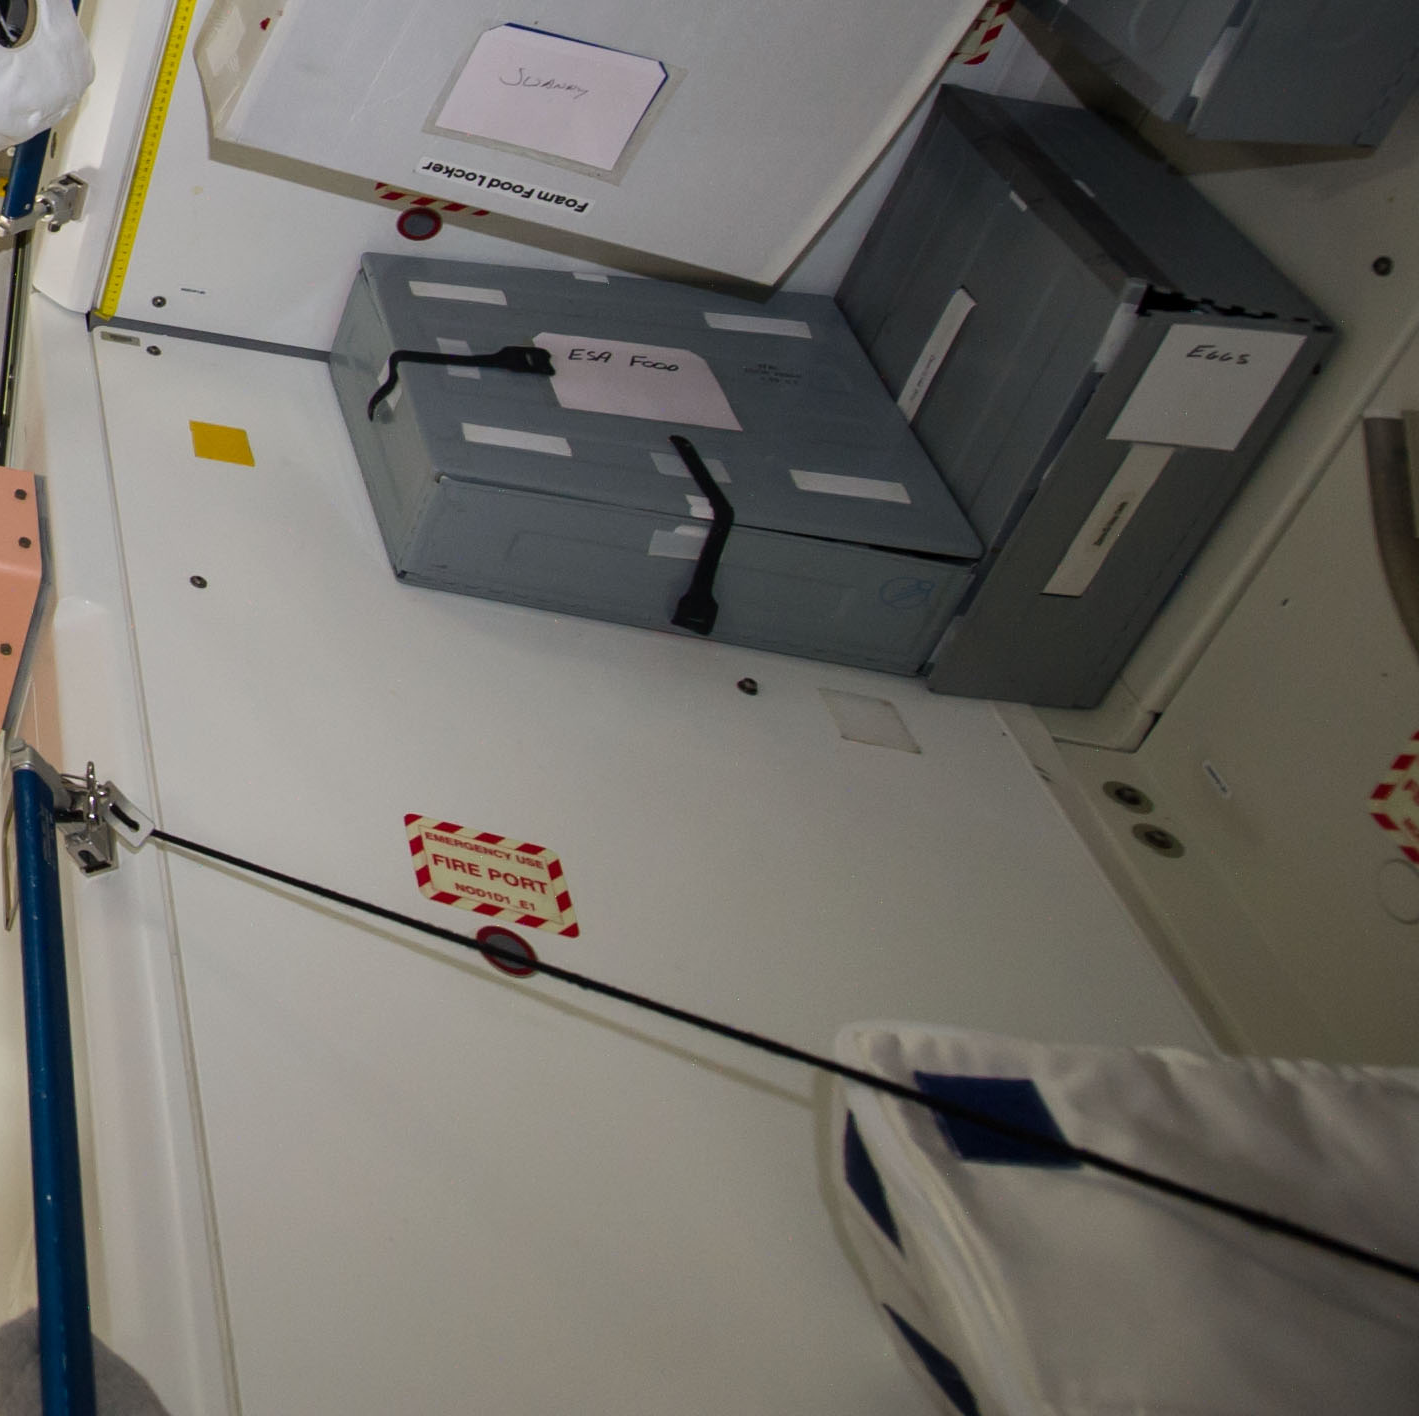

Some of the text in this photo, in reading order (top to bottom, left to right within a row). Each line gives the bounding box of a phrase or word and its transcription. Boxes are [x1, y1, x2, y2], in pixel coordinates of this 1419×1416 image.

[422, 157, 590, 214] Foam Food Locker
[567, 347, 612, 364] ESA
[423, 830, 547, 871] EMERGENCY USE
[431, 853, 550, 896] FIRE PORT
